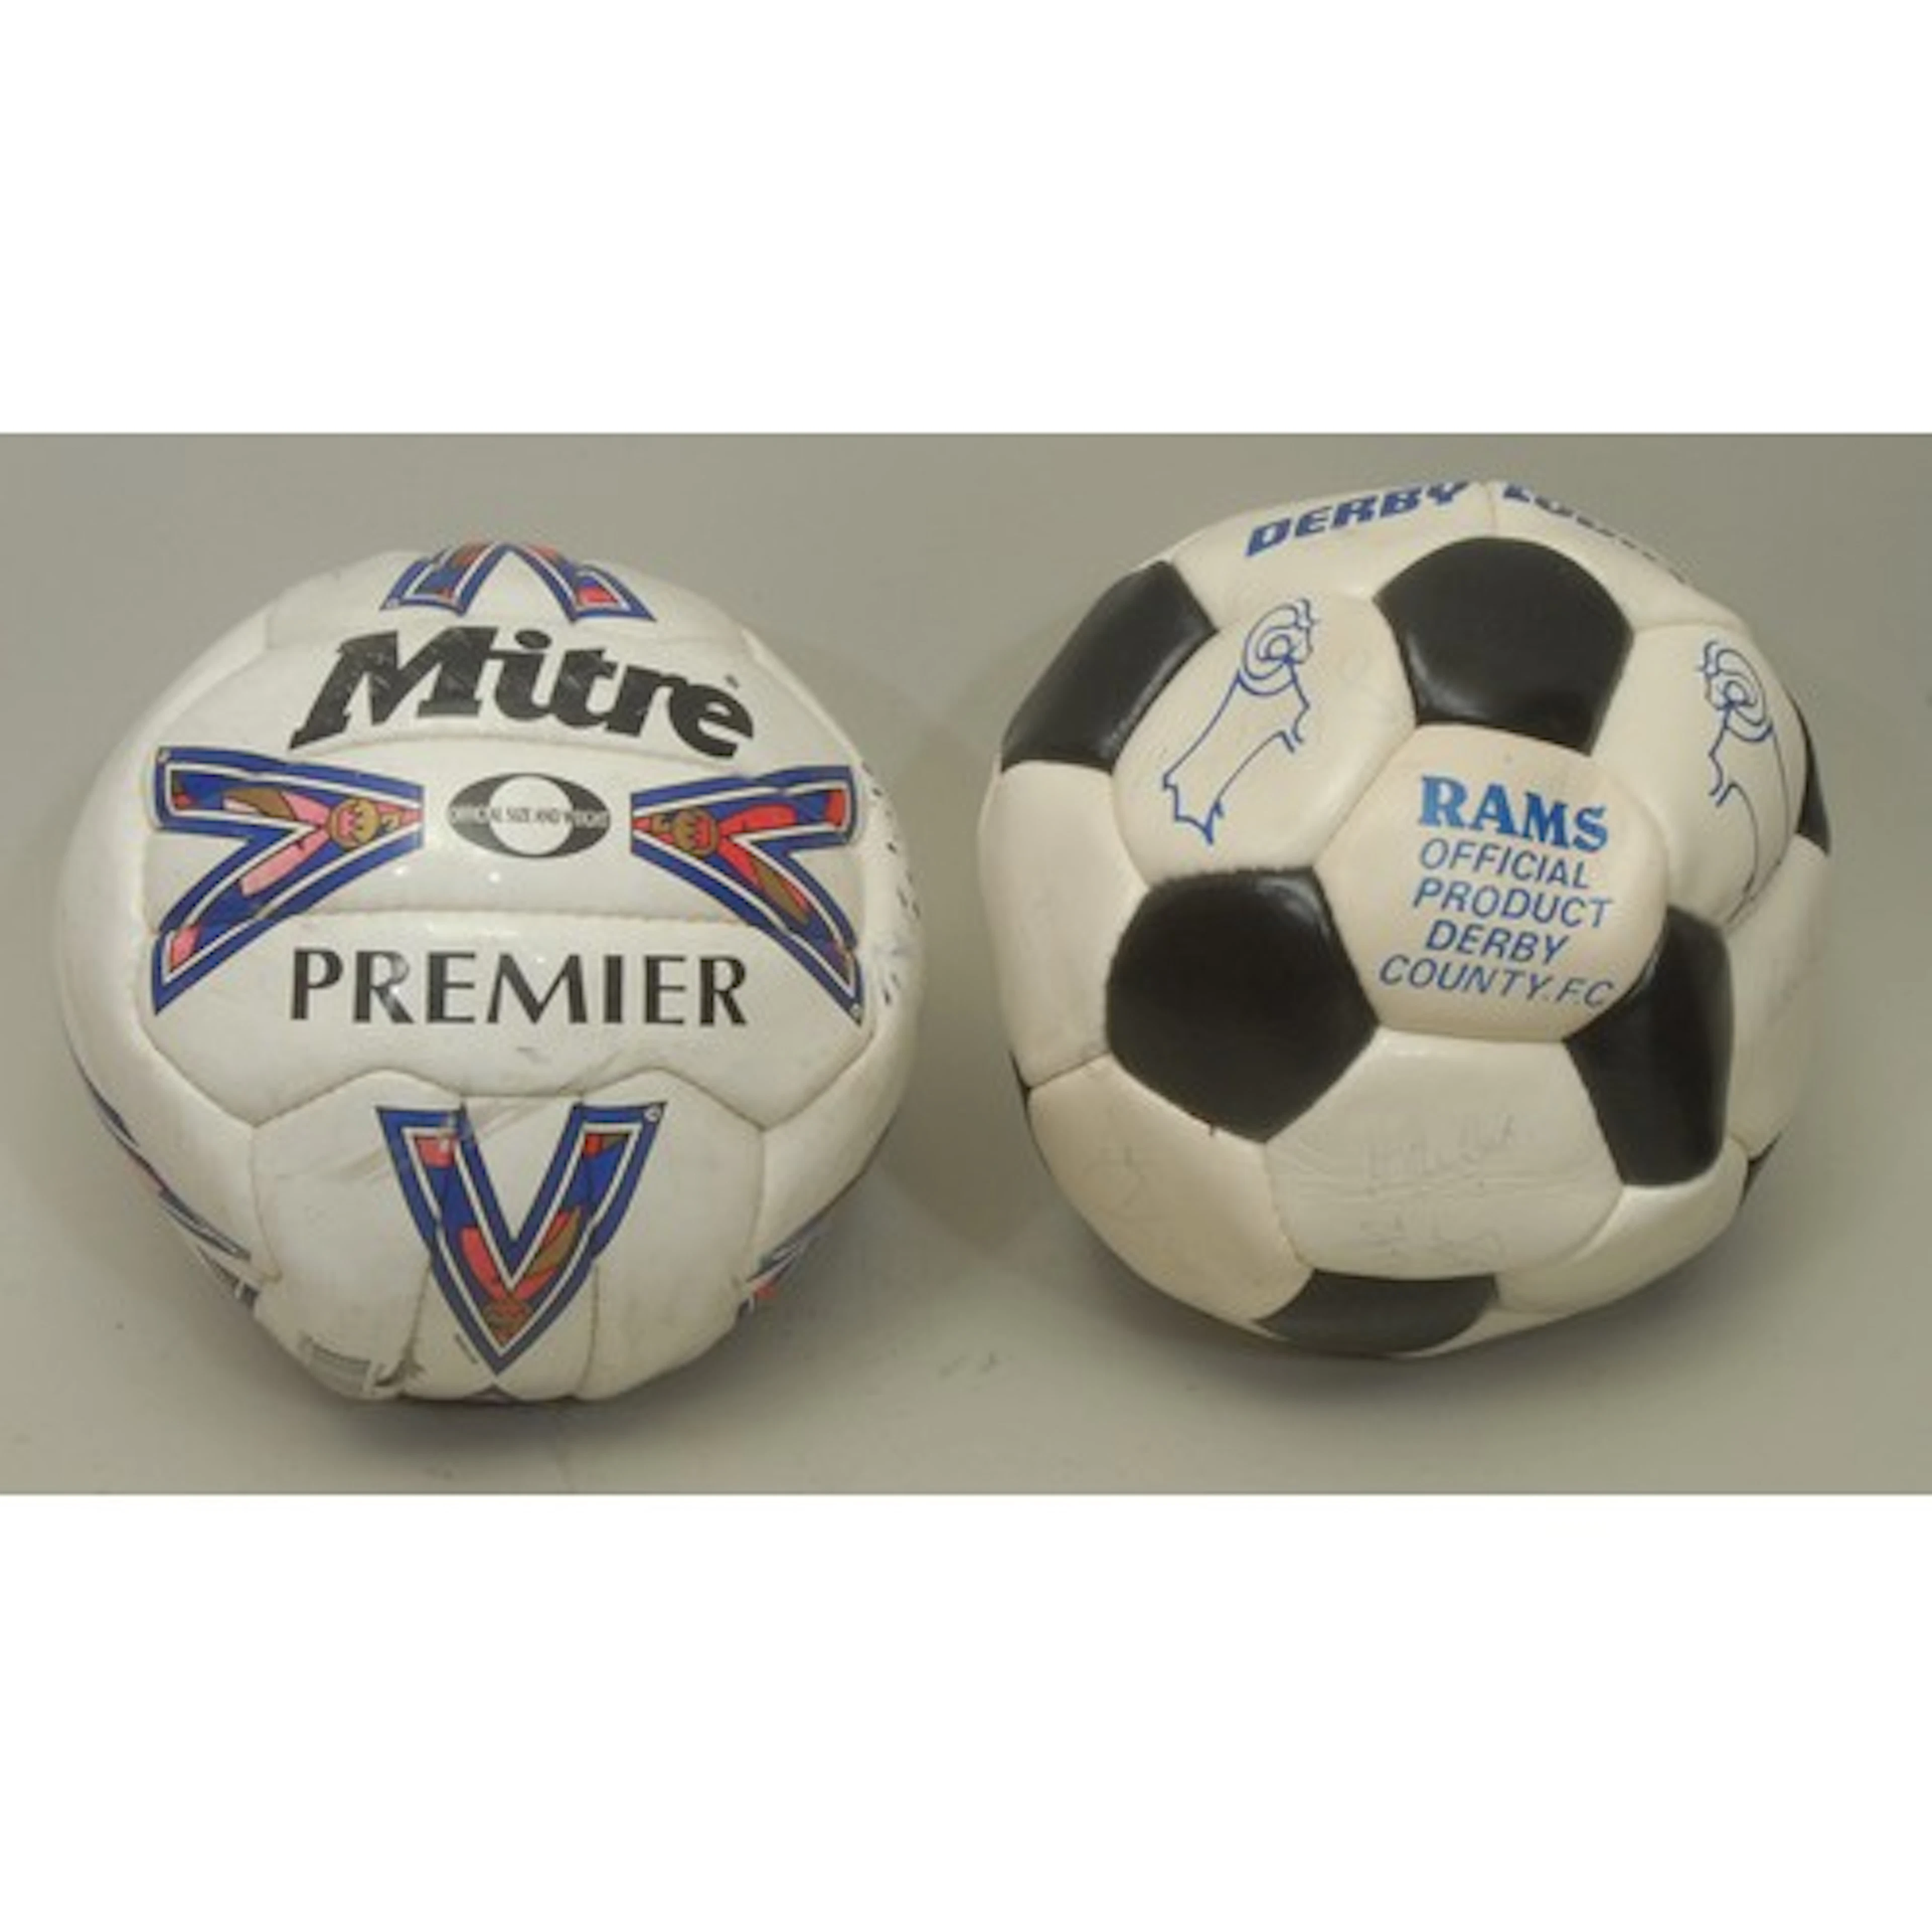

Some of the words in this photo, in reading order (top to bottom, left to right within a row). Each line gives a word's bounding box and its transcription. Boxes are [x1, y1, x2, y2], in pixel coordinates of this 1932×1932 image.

[1244, 481, 1471, 558] DERBY
[288, 626, 754, 760] Mitre
[1418, 775, 1609, 854] RAMS
[1419, 837, 1590, 890] OFFICIAL
[1413, 876, 1613, 929] PRODUCT
[1424, 919, 1569, 965] DERBY
[288, 947, 750, 1026] PREMIER
